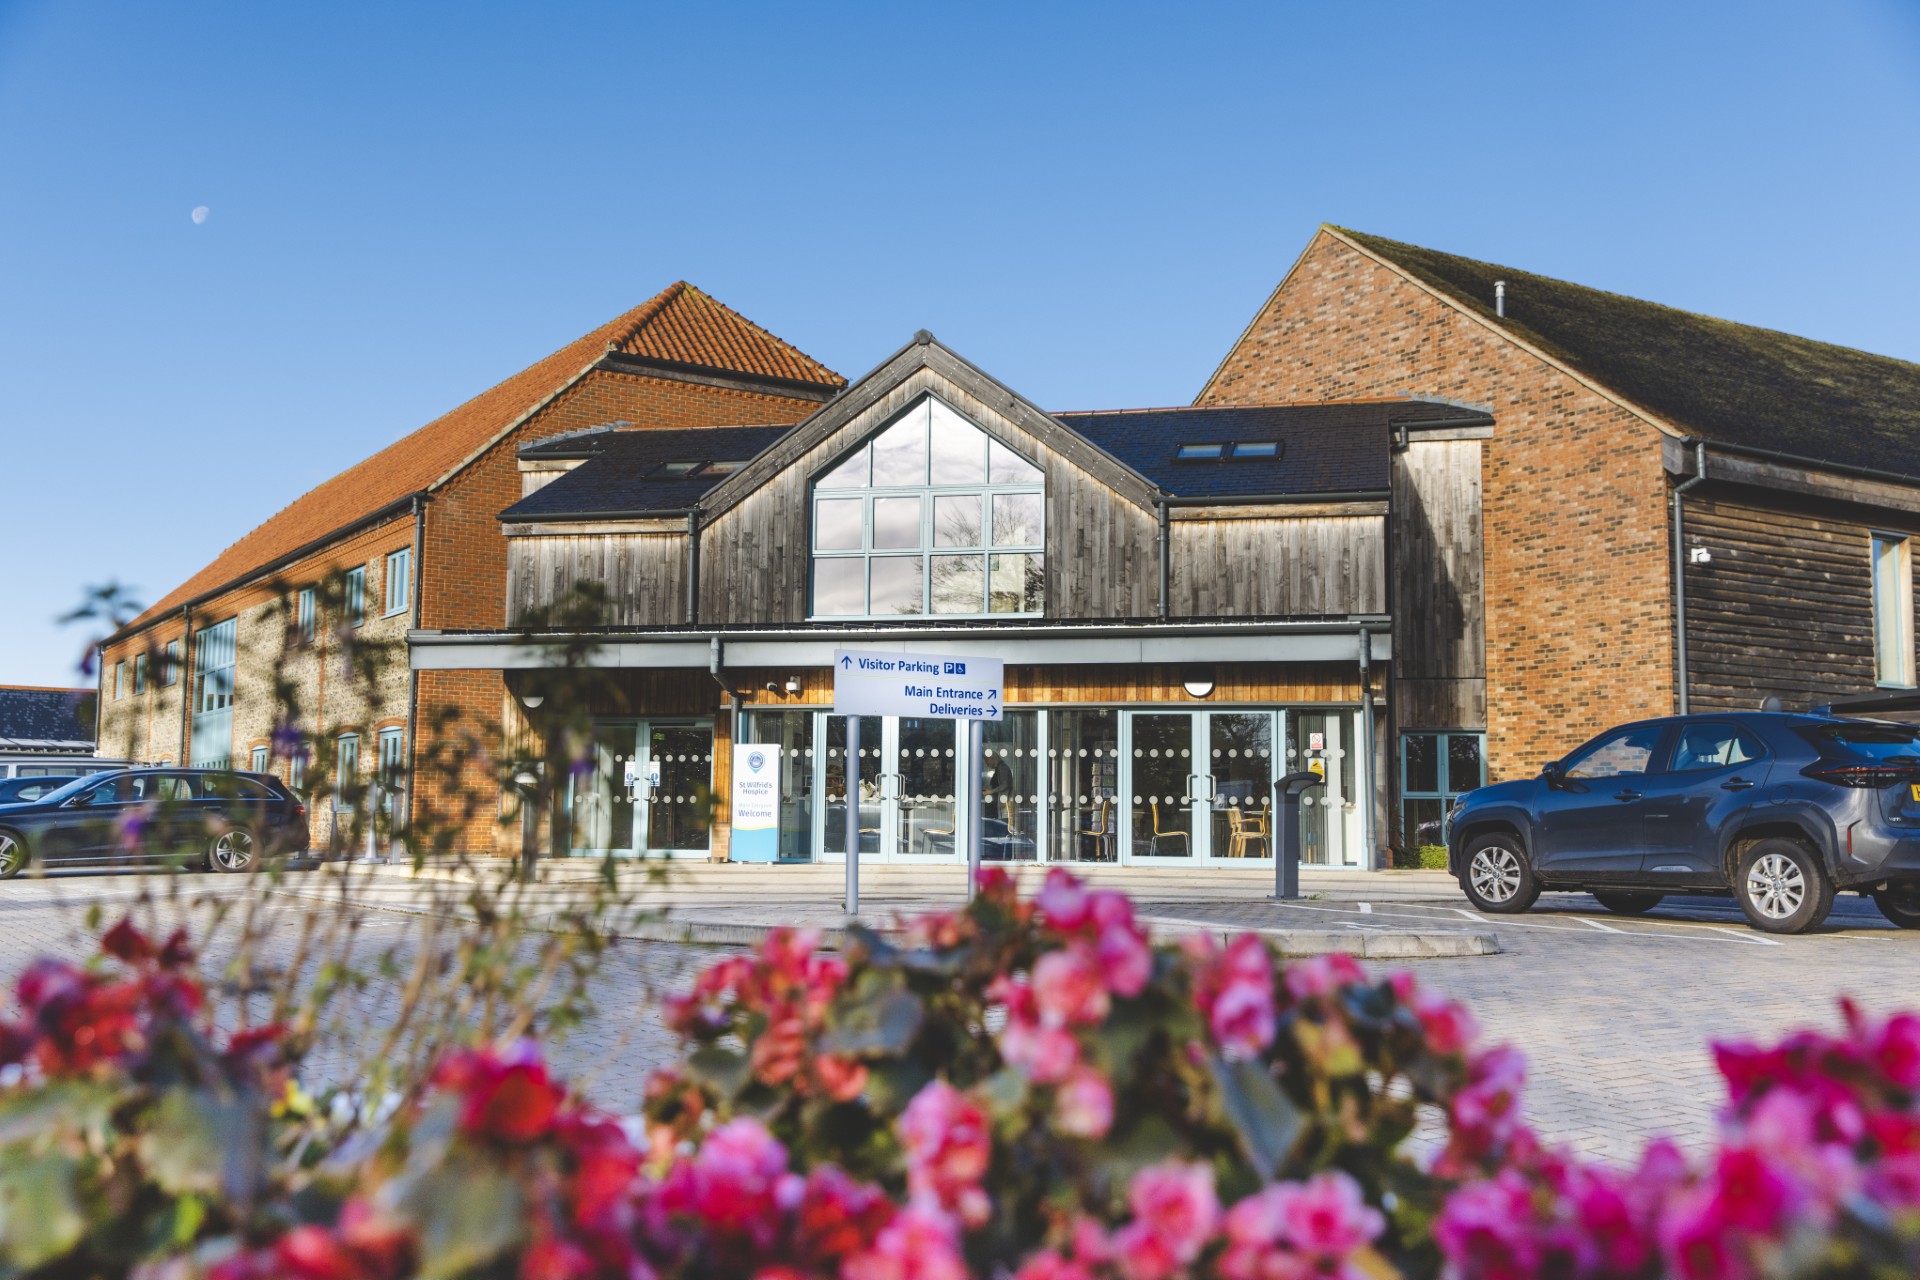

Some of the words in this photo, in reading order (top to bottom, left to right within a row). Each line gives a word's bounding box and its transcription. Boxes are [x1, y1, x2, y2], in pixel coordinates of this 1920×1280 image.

[858, 658, 895, 671] Visitor
[898, 660, 940, 675] Parking
[904, 685, 933, 697] Main
[936, 687, 983, 699] Entrance
[930, 703, 983, 716] Deliveries
[737, 809, 772, 817] Welcome
